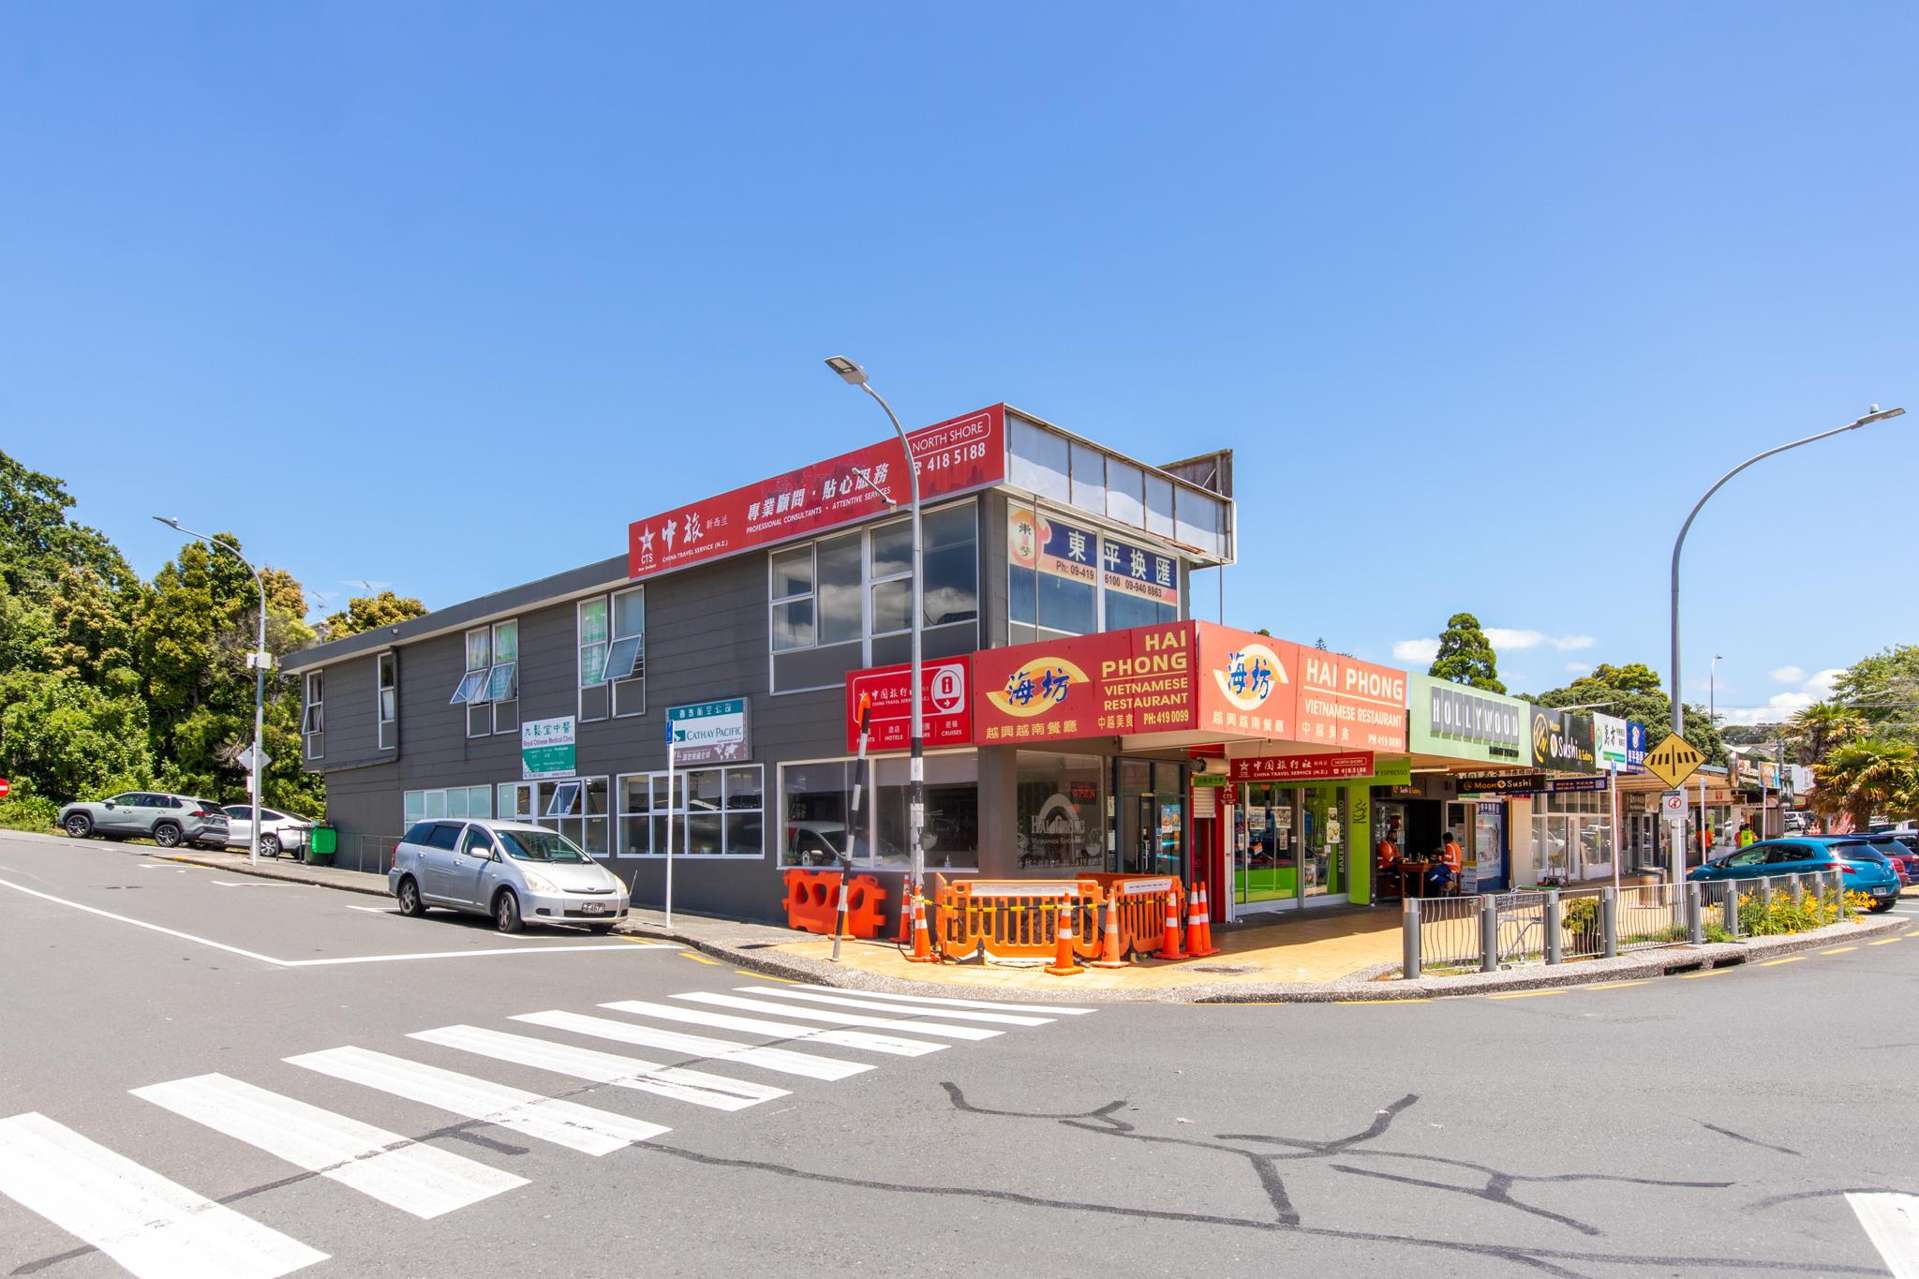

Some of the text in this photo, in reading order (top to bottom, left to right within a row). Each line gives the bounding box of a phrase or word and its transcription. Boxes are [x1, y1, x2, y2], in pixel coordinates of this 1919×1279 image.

[912, 420, 984, 453] NORTH SHORE
[927, 442, 986, 472] 418 5188
[746, 518, 782, 535] PROFESSIONAL
[783, 506, 823, 524] CONSULTANTS
[832, 496, 863, 511] ATTENTIVE
[641, 552, 654, 565] CTS
[662, 553, 677, 563] CHINA
[677, 550, 694, 560] TRAVEL
[694, 544, 714, 556] SERVICE
[1144, 629, 1187, 652] HAI
[1101, 651, 1188, 678] PHONG
[1103, 677, 1189, 697] VIETNAMESE
[1306, 657, 1404, 700] HAI PHONG
[1103, 692, 1189, 712] RESTAURANT
[1304, 698, 1402, 729] VIETNAMESE RESTAURANT
[1432, 695, 1519, 737] HOLLYWOOD
[1558, 734, 1579, 761] Sushi
[1507, 778, 1532, 788] Sushi
